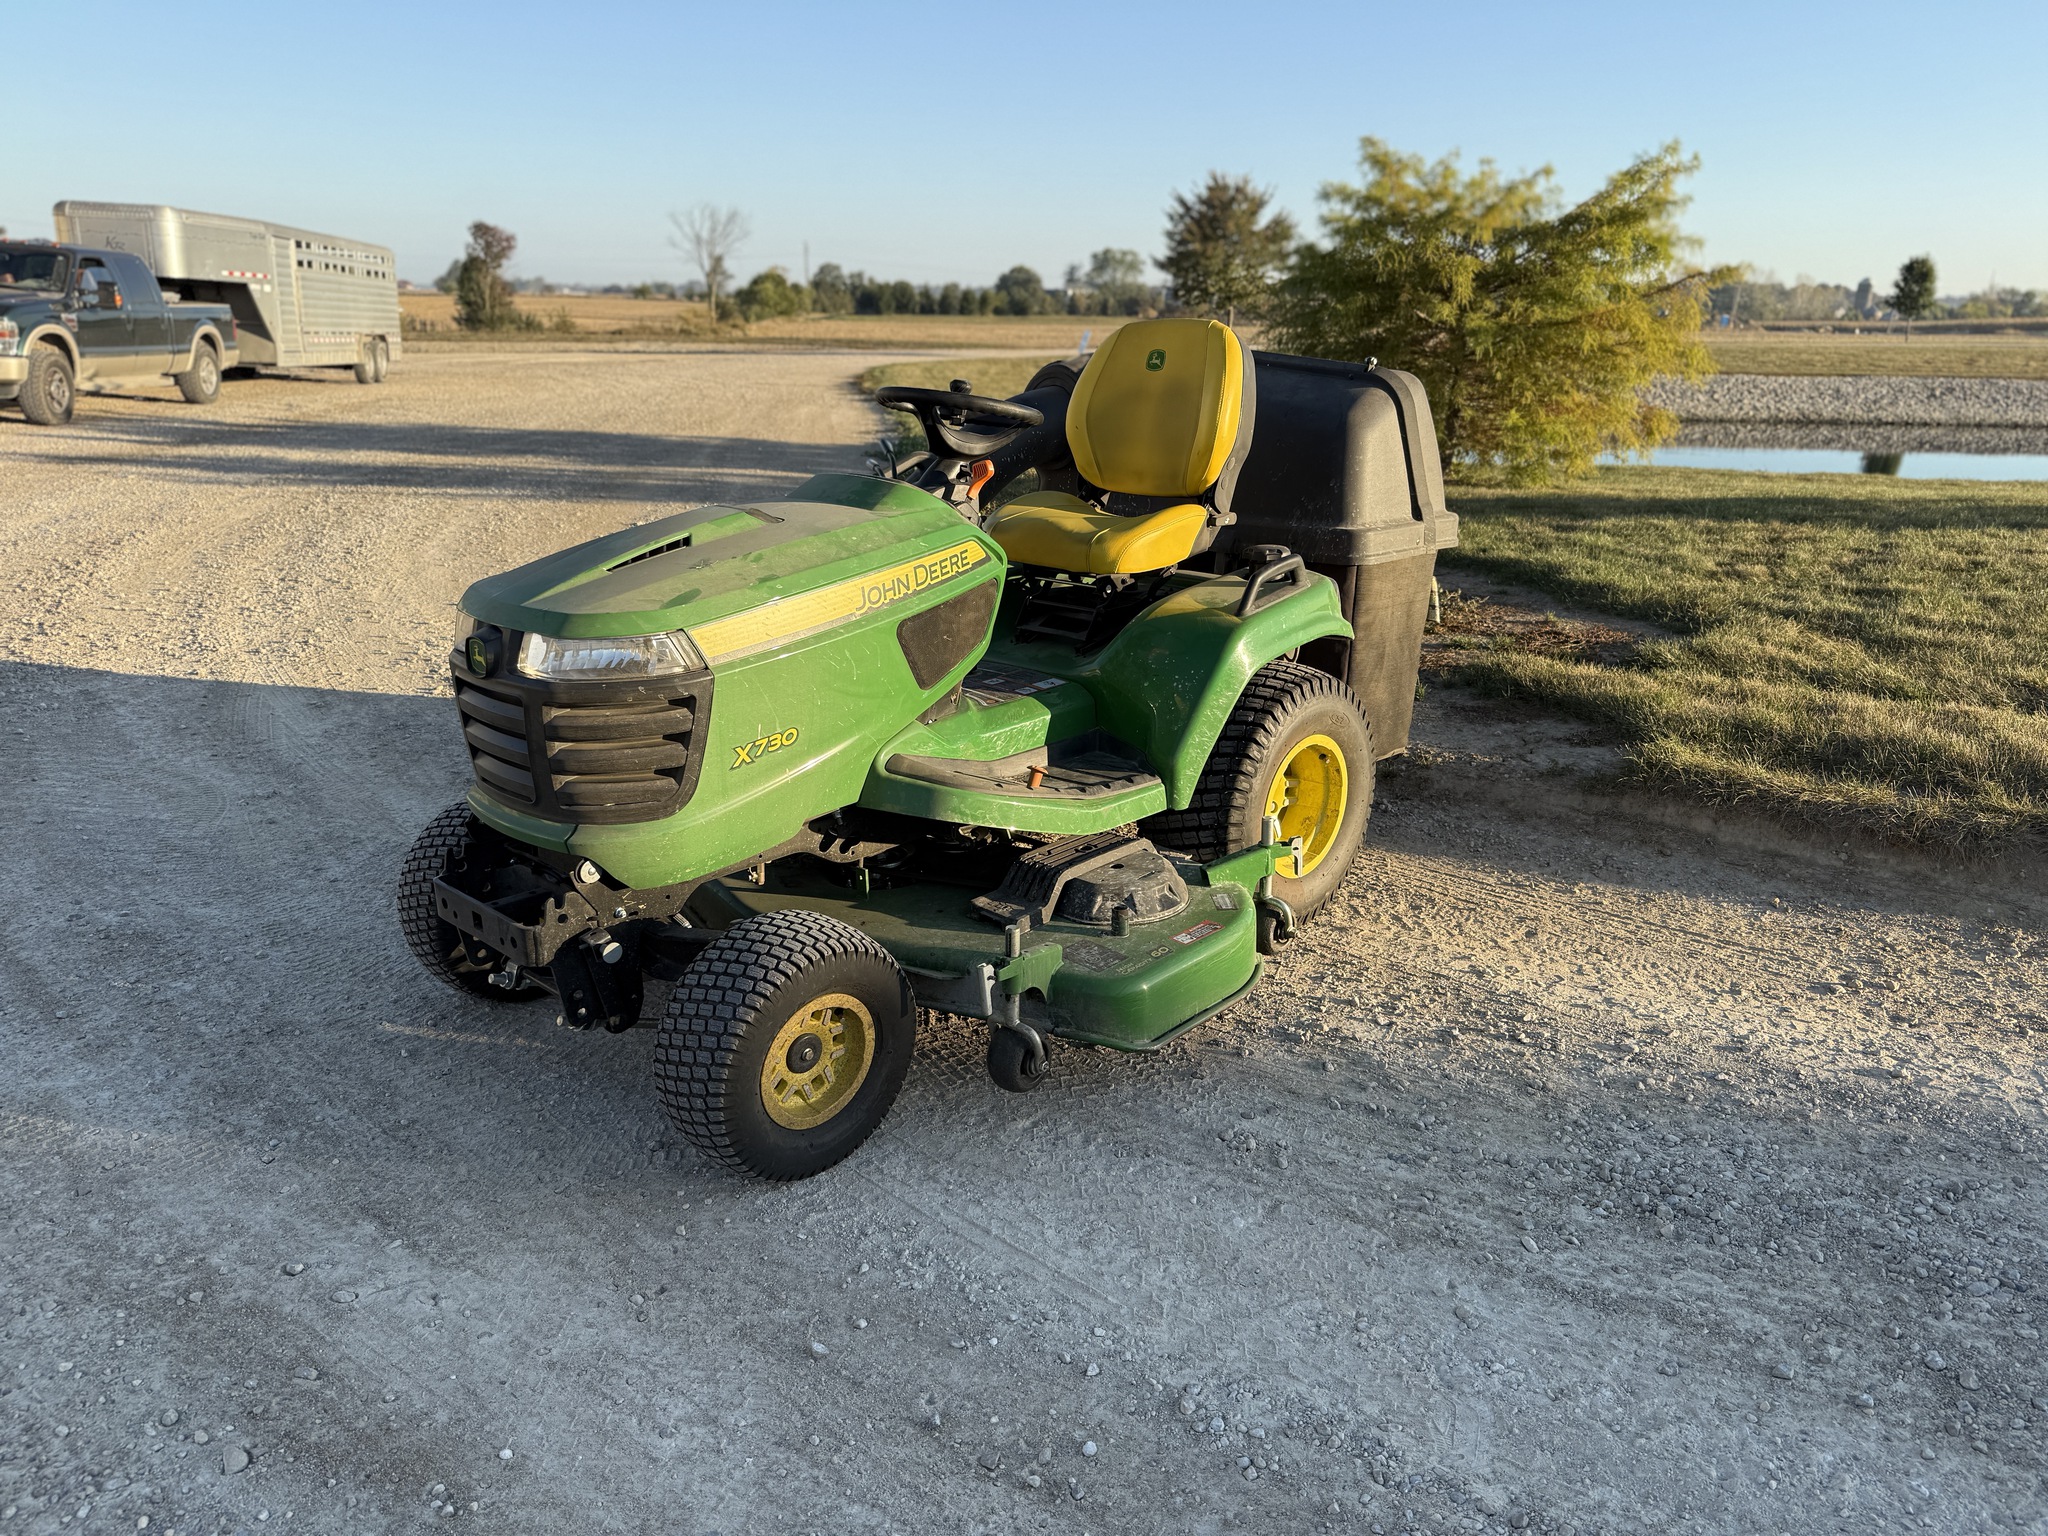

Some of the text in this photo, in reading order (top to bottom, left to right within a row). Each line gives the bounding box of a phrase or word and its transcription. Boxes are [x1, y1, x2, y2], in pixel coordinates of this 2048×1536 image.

[855, 548, 971, 612] JOHN DEERE
[730, 727, 799, 770] X730
[1150, 946, 1169, 958] 60
